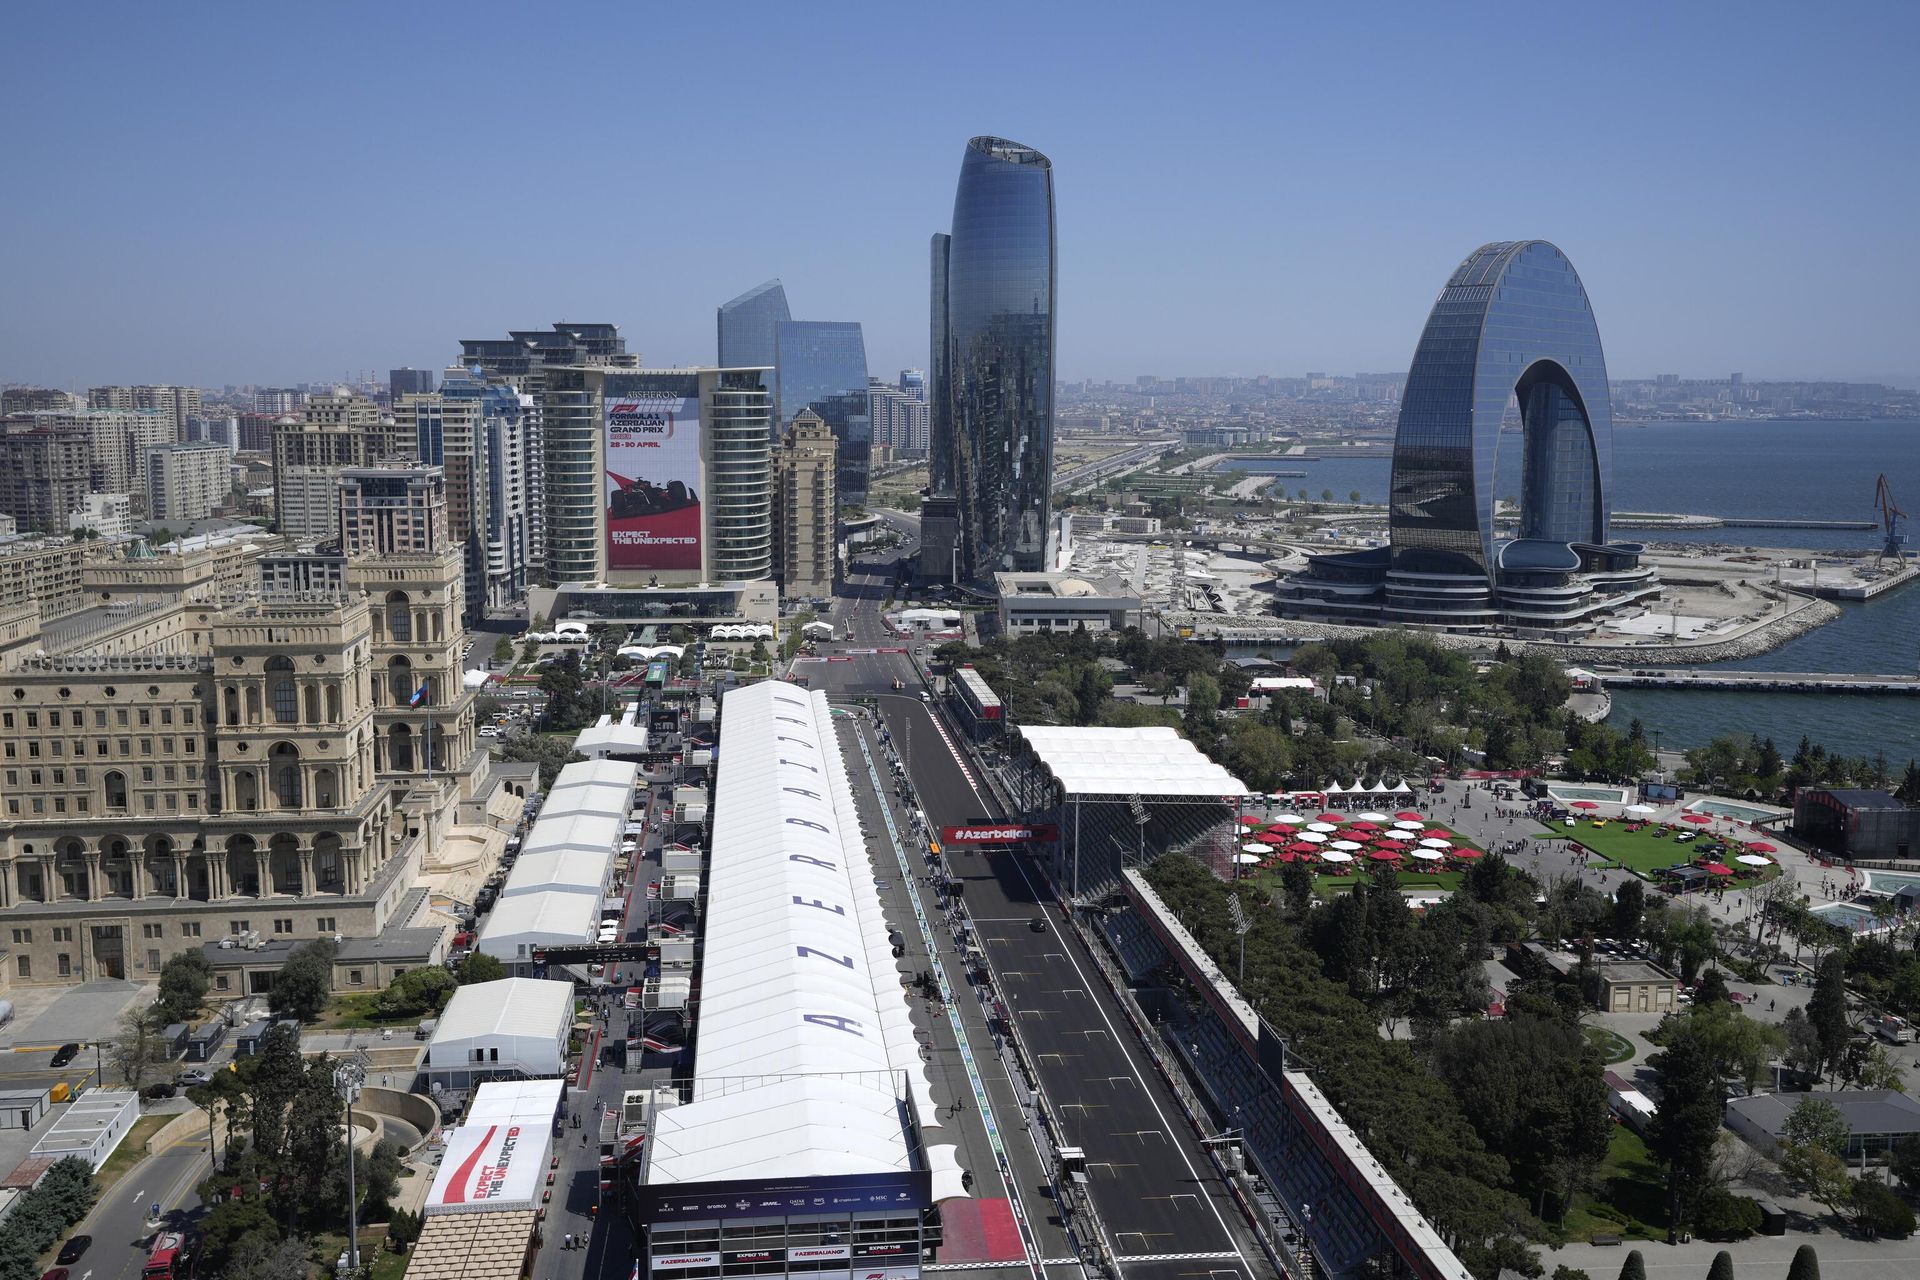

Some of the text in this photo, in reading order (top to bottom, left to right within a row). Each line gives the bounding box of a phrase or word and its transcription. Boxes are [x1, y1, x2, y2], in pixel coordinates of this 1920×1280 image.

[955, 829, 1048, 839] #Azerbaijan
[486, 1126, 521, 1199] THE UNEXPECTED
[473, 1165, 495, 1199] EXPECT
[661, 1257, 712, 1265] #AZERBAIJANGP
